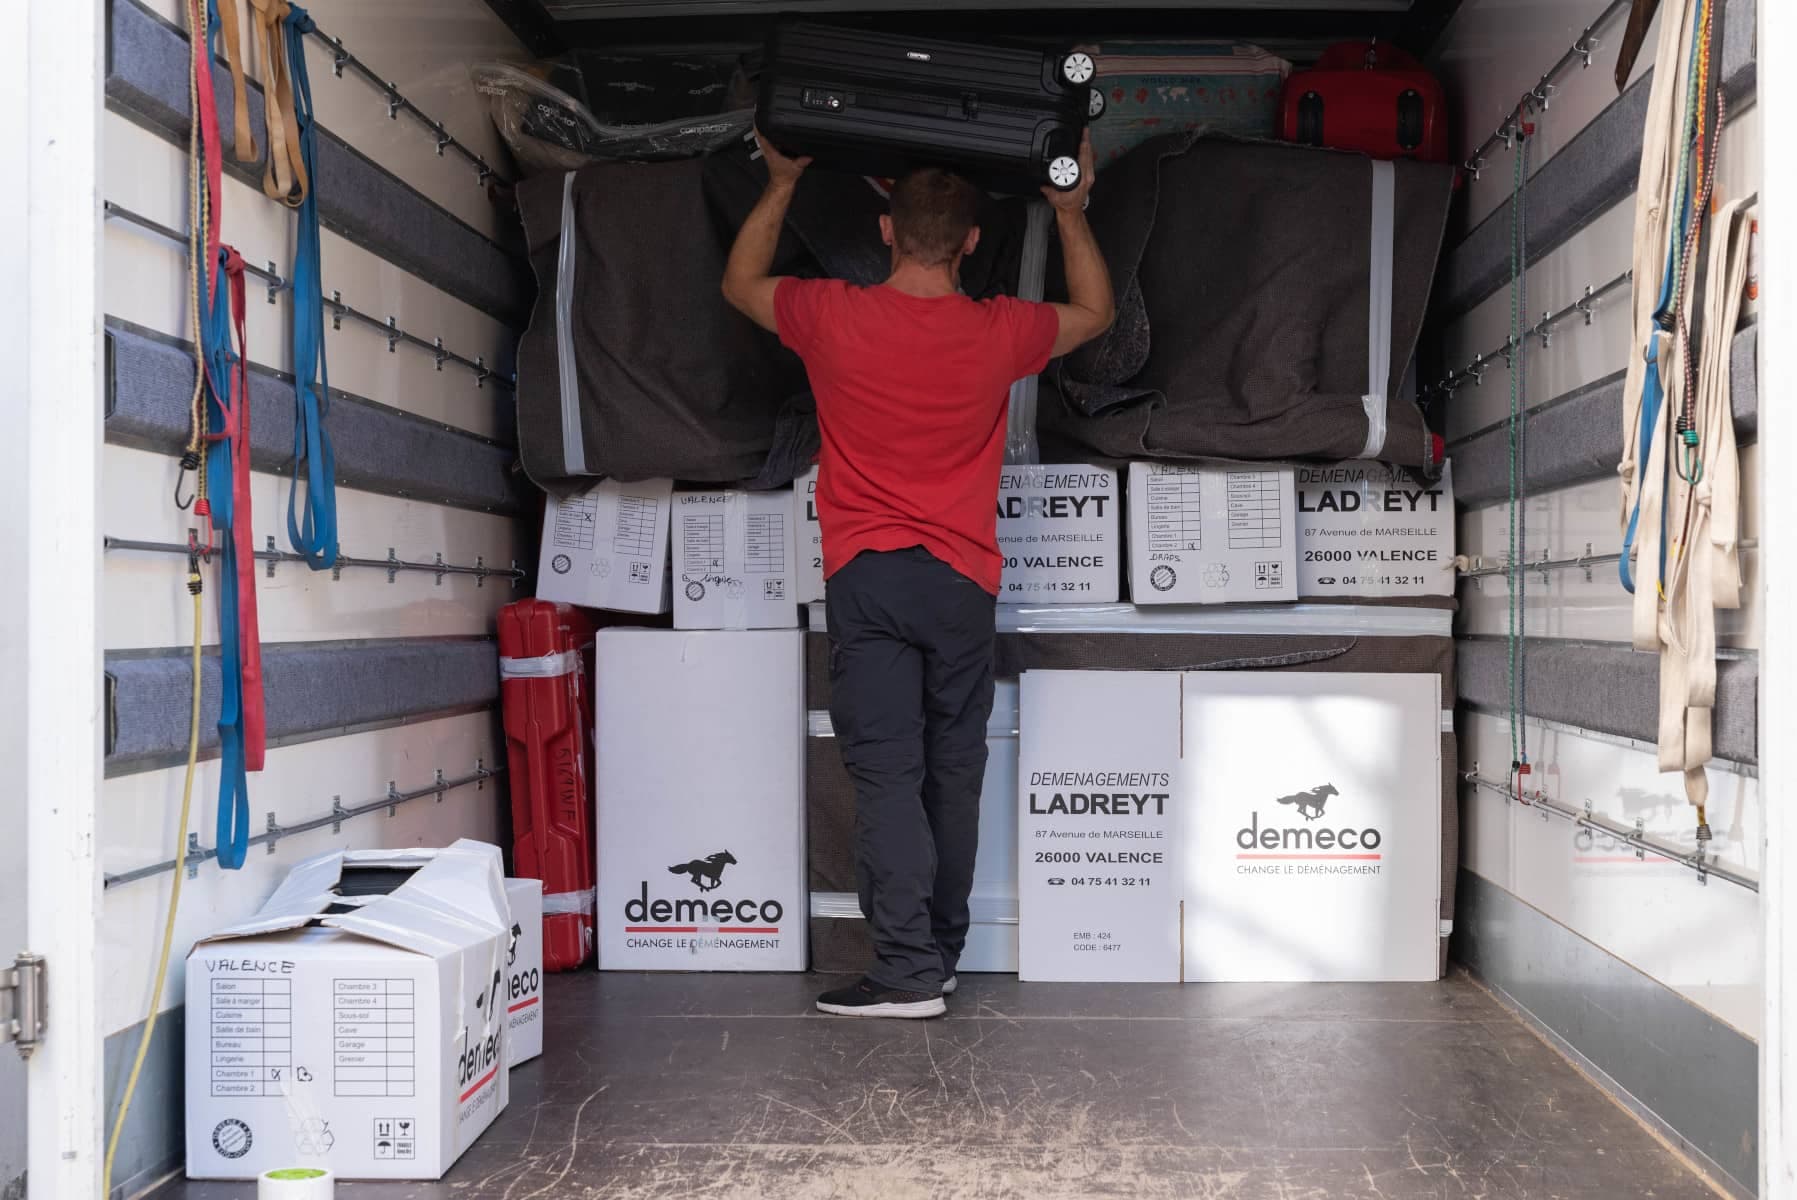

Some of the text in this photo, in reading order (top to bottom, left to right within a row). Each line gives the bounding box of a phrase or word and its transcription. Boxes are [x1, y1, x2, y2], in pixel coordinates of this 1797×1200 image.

[999, 473, 1110, 490] ENAGEMENTS
[1298, 490, 1444, 513] LADREYT
[1025, 533, 1039, 544] de
[1040, 532, 1105, 543] MARSEILLE
[1304, 527, 1440, 537] 87 Avenue de MARSEILLE
[1022, 556, 1105, 568] VALENCE
[1303, 549, 1439, 563] 26000 VALENCE
[1341, 575, 1357, 585] 04
[1393, 575, 1410, 585] 32
[1412, 575, 1425, 585] 11
[1007, 582, 1023, 592] 04
[1060, 581, 1076, 592] 32
[1078, 581, 1091, 591] 11
[1029, 771, 1171, 787] DEMENAGEMENTS
[1028, 793, 1170, 816] LADREYT
[1034, 830, 1164, 839] 87 Avenue de MARSEILLE
[1236, 811, 1382, 850] demeco
[1034, 851, 1164, 864] 26000 VALENCE
[1236, 863, 1382, 875] CHANGE LE DÉMÉNAGEMENT
[1070, 876, 1152, 886] 04 75 41 32 11
[624, 880, 784, 923] demeco
[1097, 932, 1111, 940] 424
[626, 938, 673, 949] CHANGE
[676, 938, 687, 949] LE
[1073, 943, 1097, 951] CODE
[204, 958, 296, 974] VALENCE
[507, 967, 539, 1001] eco
